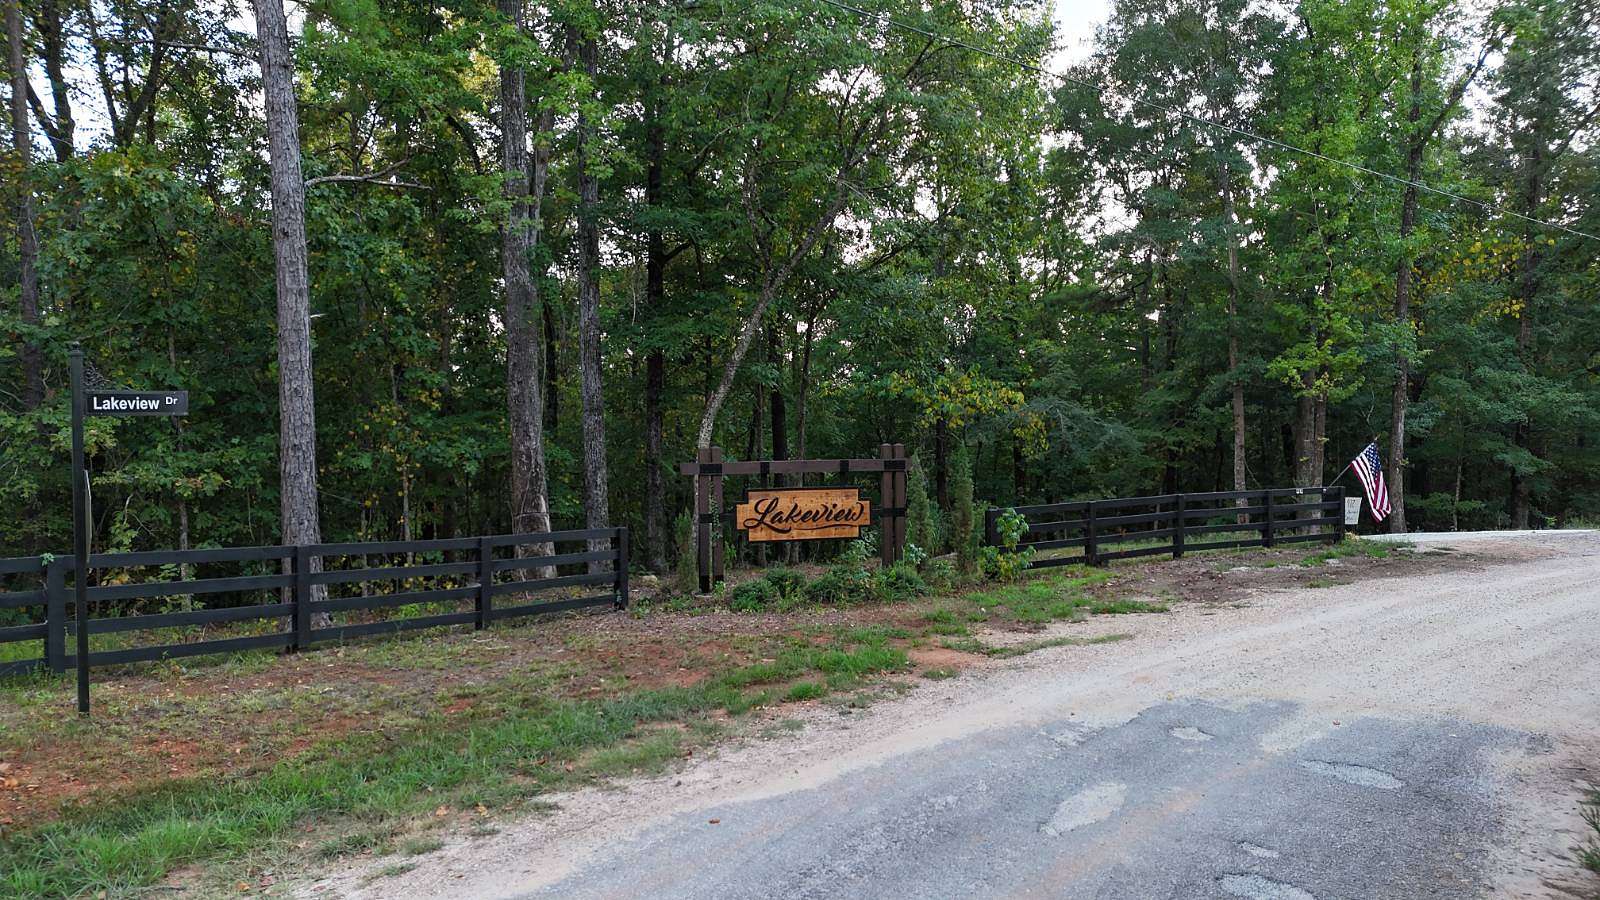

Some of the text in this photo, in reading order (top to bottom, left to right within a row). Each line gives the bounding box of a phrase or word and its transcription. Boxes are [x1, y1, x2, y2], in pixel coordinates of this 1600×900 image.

[93, 396, 178, 410] Lakeview Dr
[743, 497, 865, 534] Lakeview
